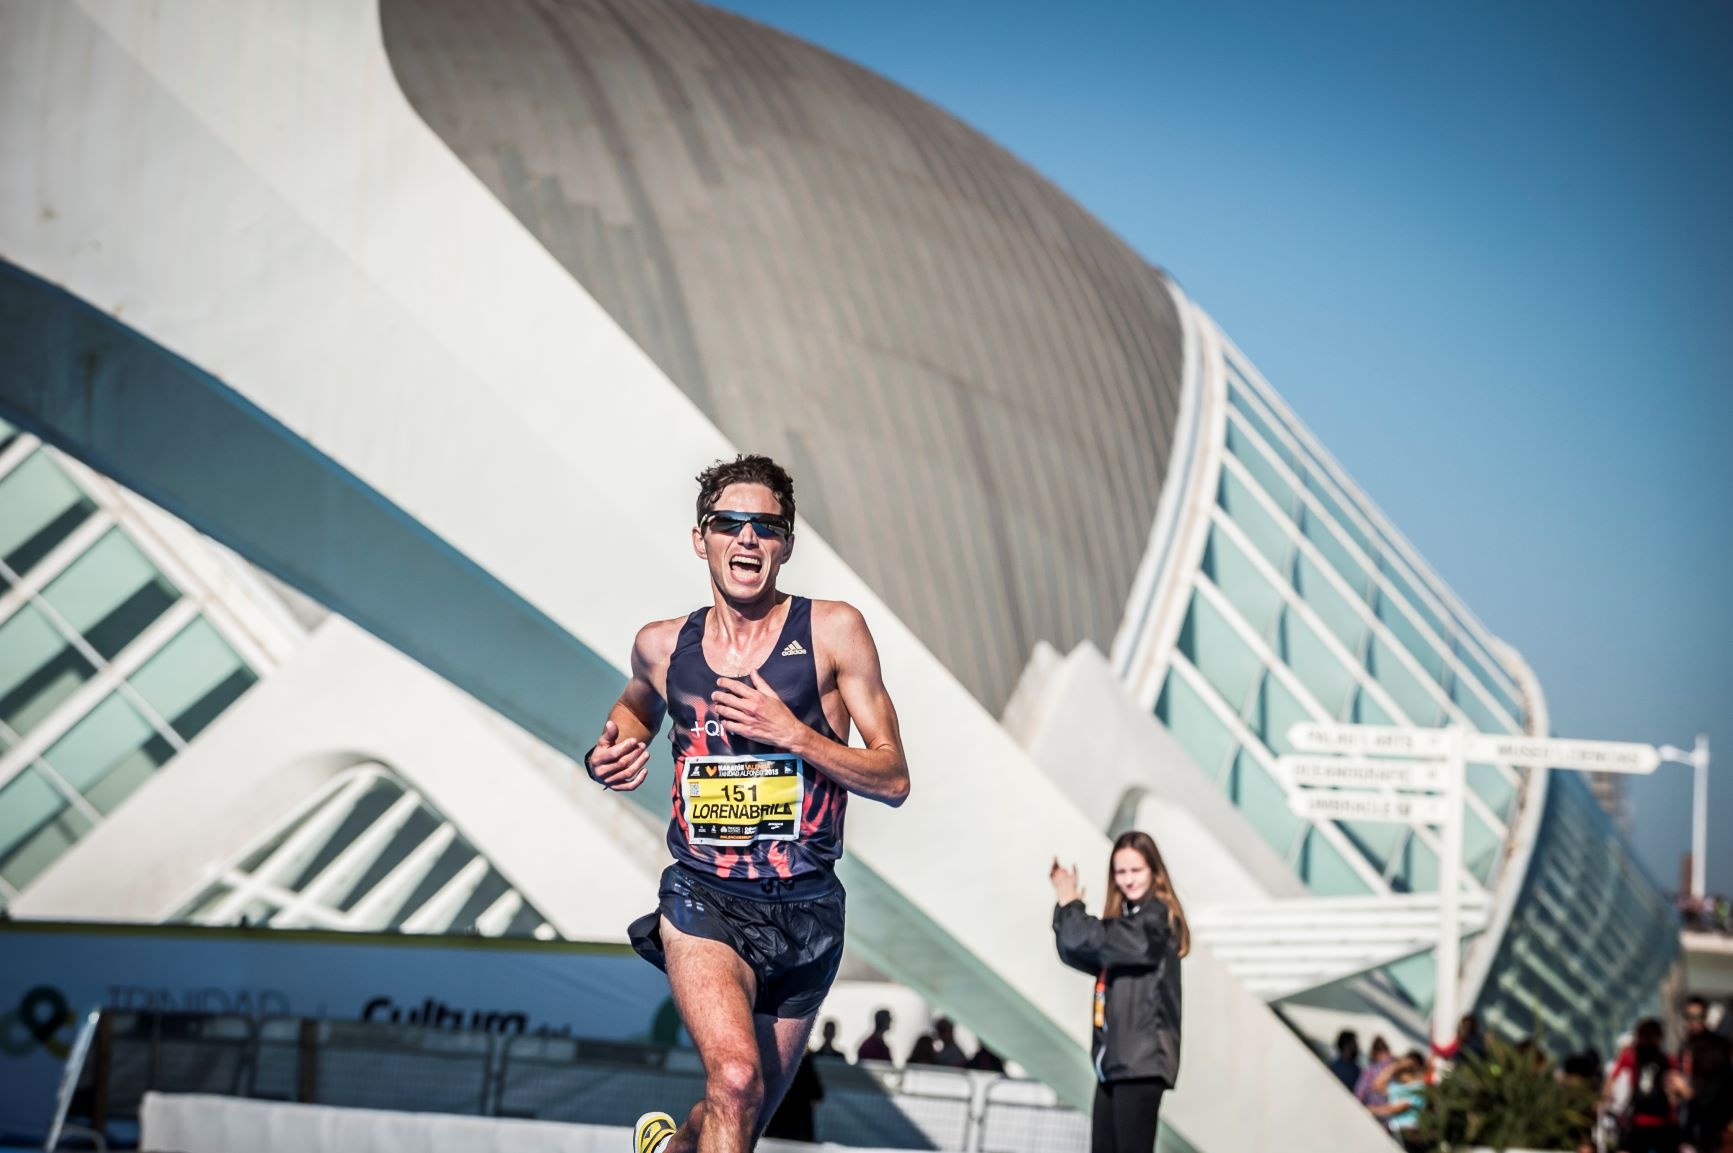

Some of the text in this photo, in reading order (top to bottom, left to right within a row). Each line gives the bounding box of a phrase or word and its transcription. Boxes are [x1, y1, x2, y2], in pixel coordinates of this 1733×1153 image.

[782, 648, 807, 656] adidas
[764, 768, 780, 776] 2015
[721, 784, 758, 802] 151
